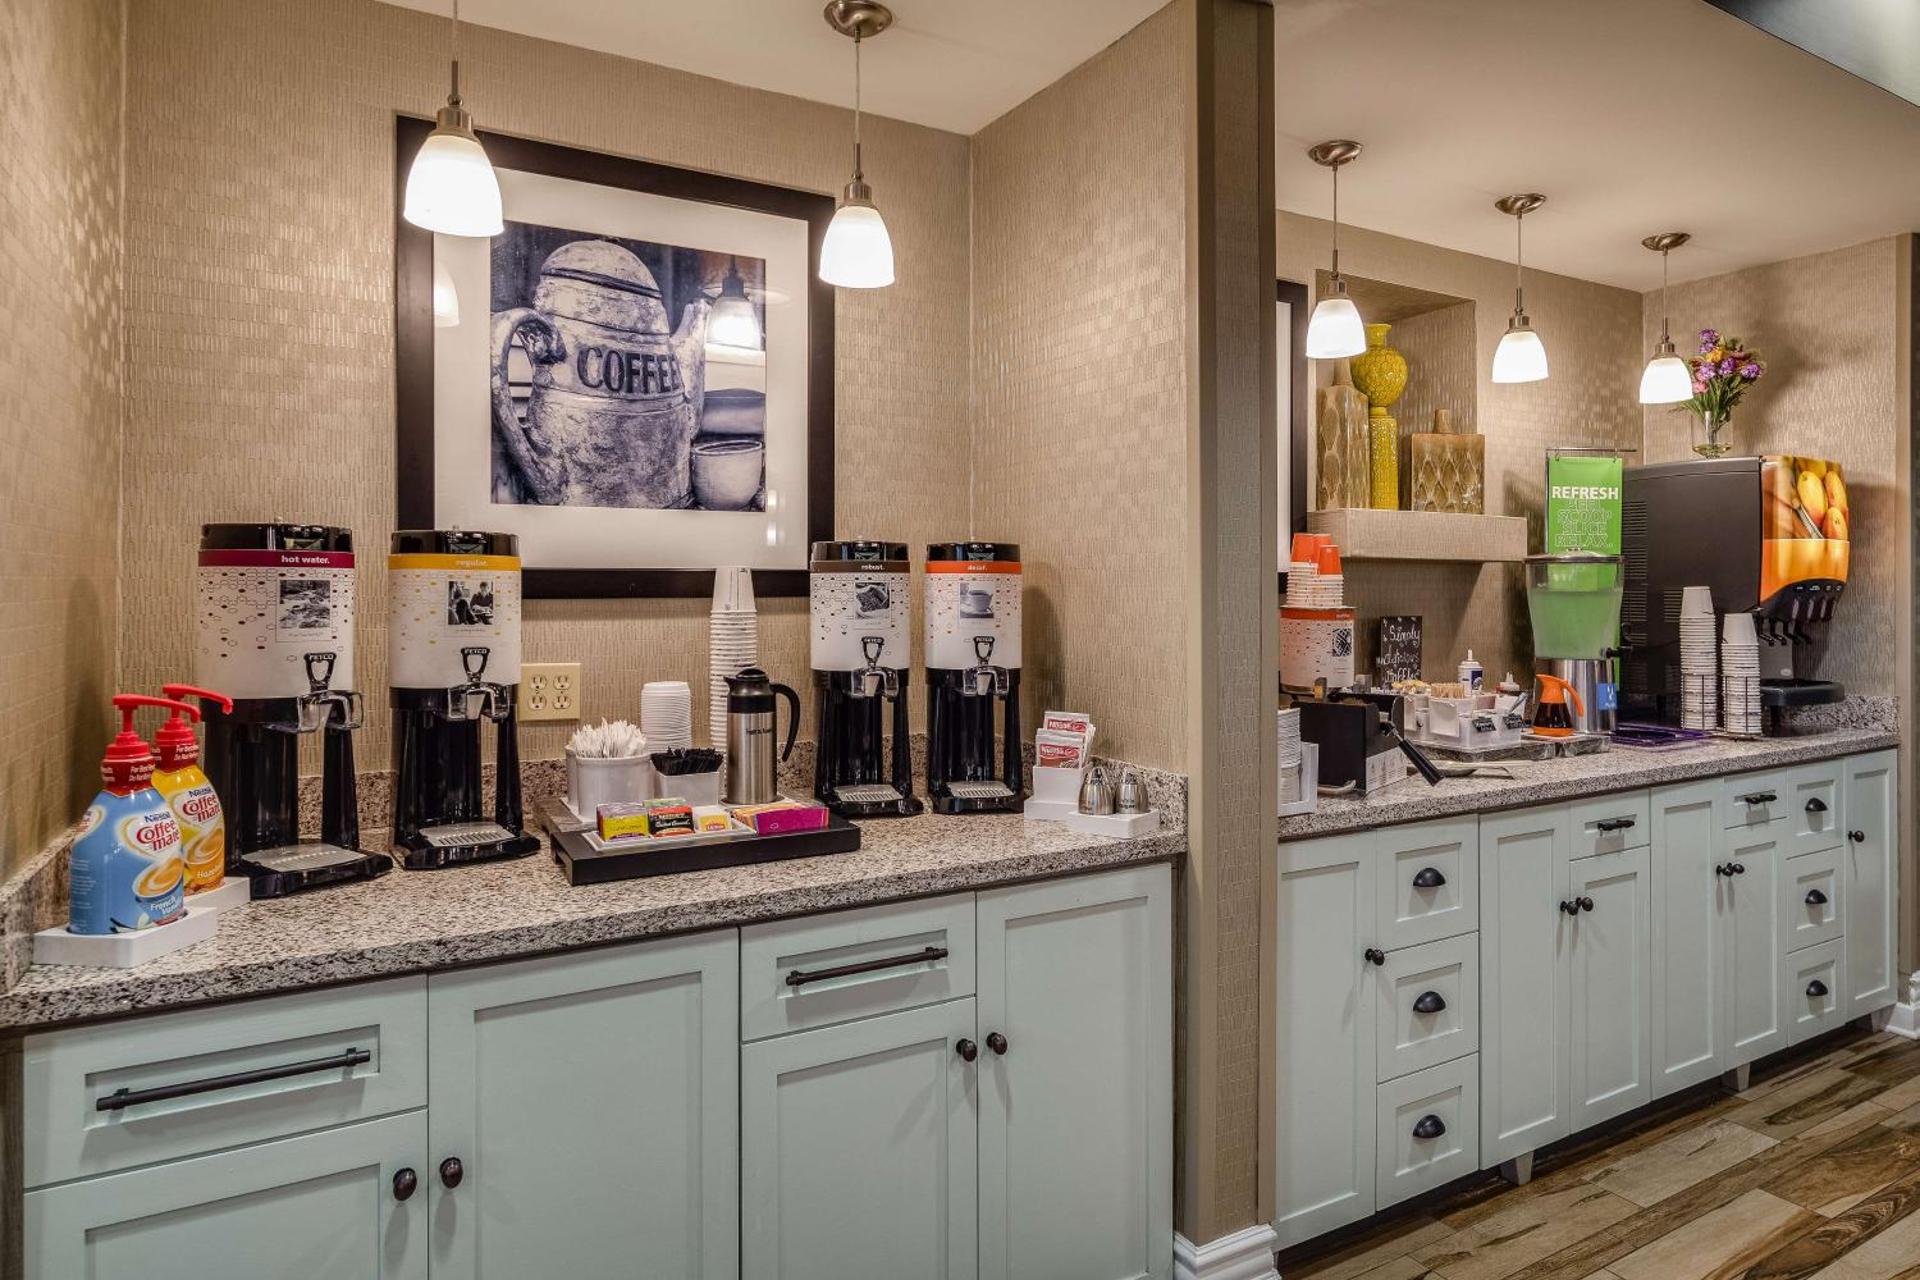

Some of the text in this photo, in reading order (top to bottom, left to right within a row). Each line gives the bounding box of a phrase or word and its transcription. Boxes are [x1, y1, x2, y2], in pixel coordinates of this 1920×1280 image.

[577, 347, 680, 394] COFFEE
[1551, 486, 1619, 500] REFRESH
[1558, 510, 1611, 523] SCOOP
[1562, 522, 1607, 535] SLICE
[281, 554, 330, 565] hot water.
[860, 563, 885, 571] robust.
[1389, 625, 1420, 648] Simply
[183, 795, 216, 816] Coffee
[136, 820, 176, 844] Coffee
